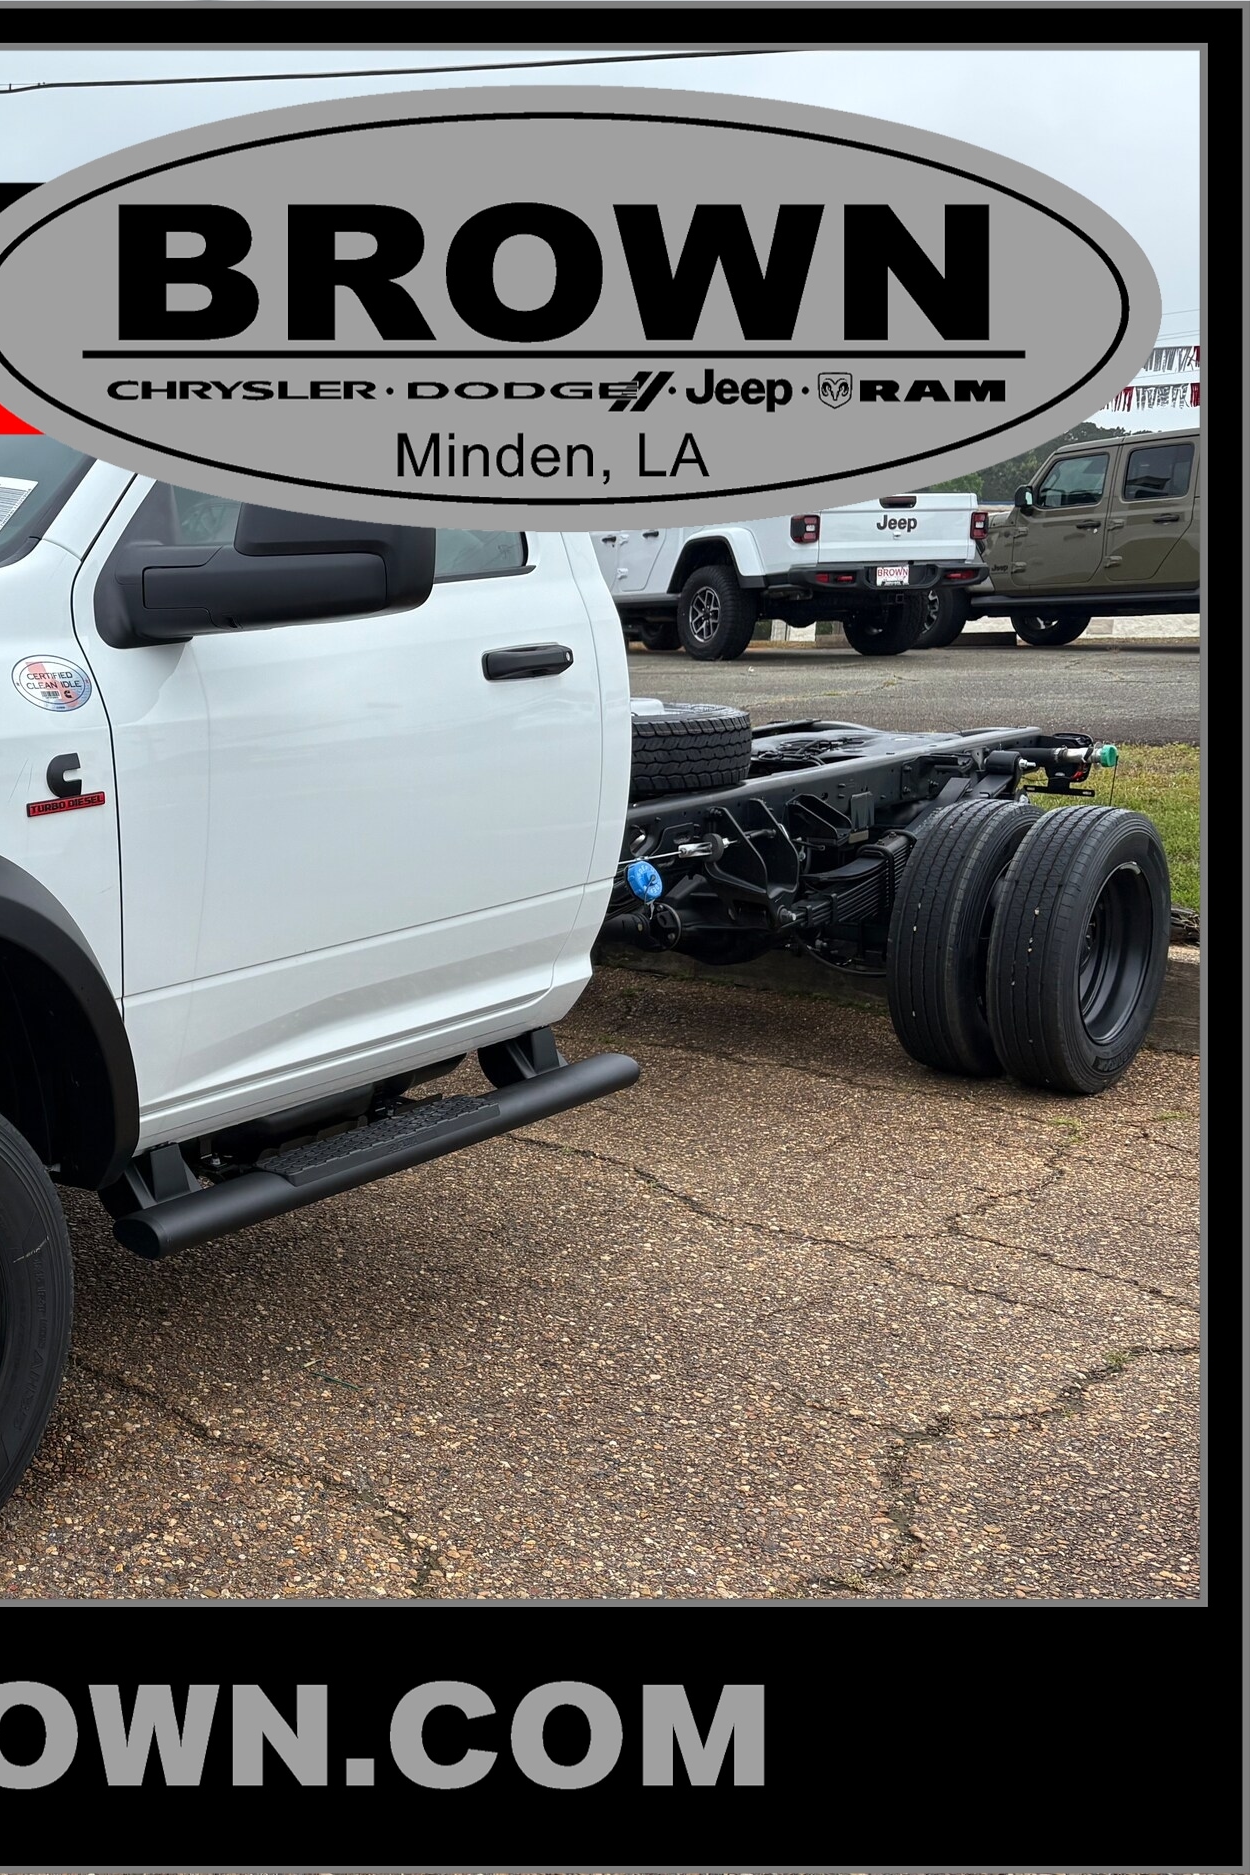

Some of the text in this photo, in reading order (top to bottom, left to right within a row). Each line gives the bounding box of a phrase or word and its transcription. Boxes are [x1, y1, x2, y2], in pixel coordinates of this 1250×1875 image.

[876, 515, 918, 532] Jeep
[877, 569, 908, 577] BROWN
[26, 671, 73, 681] CERTIFIED
[26, 680, 82, 690] CLEAN IDLE
[30, 794, 103, 814] TURBO DIESEL
